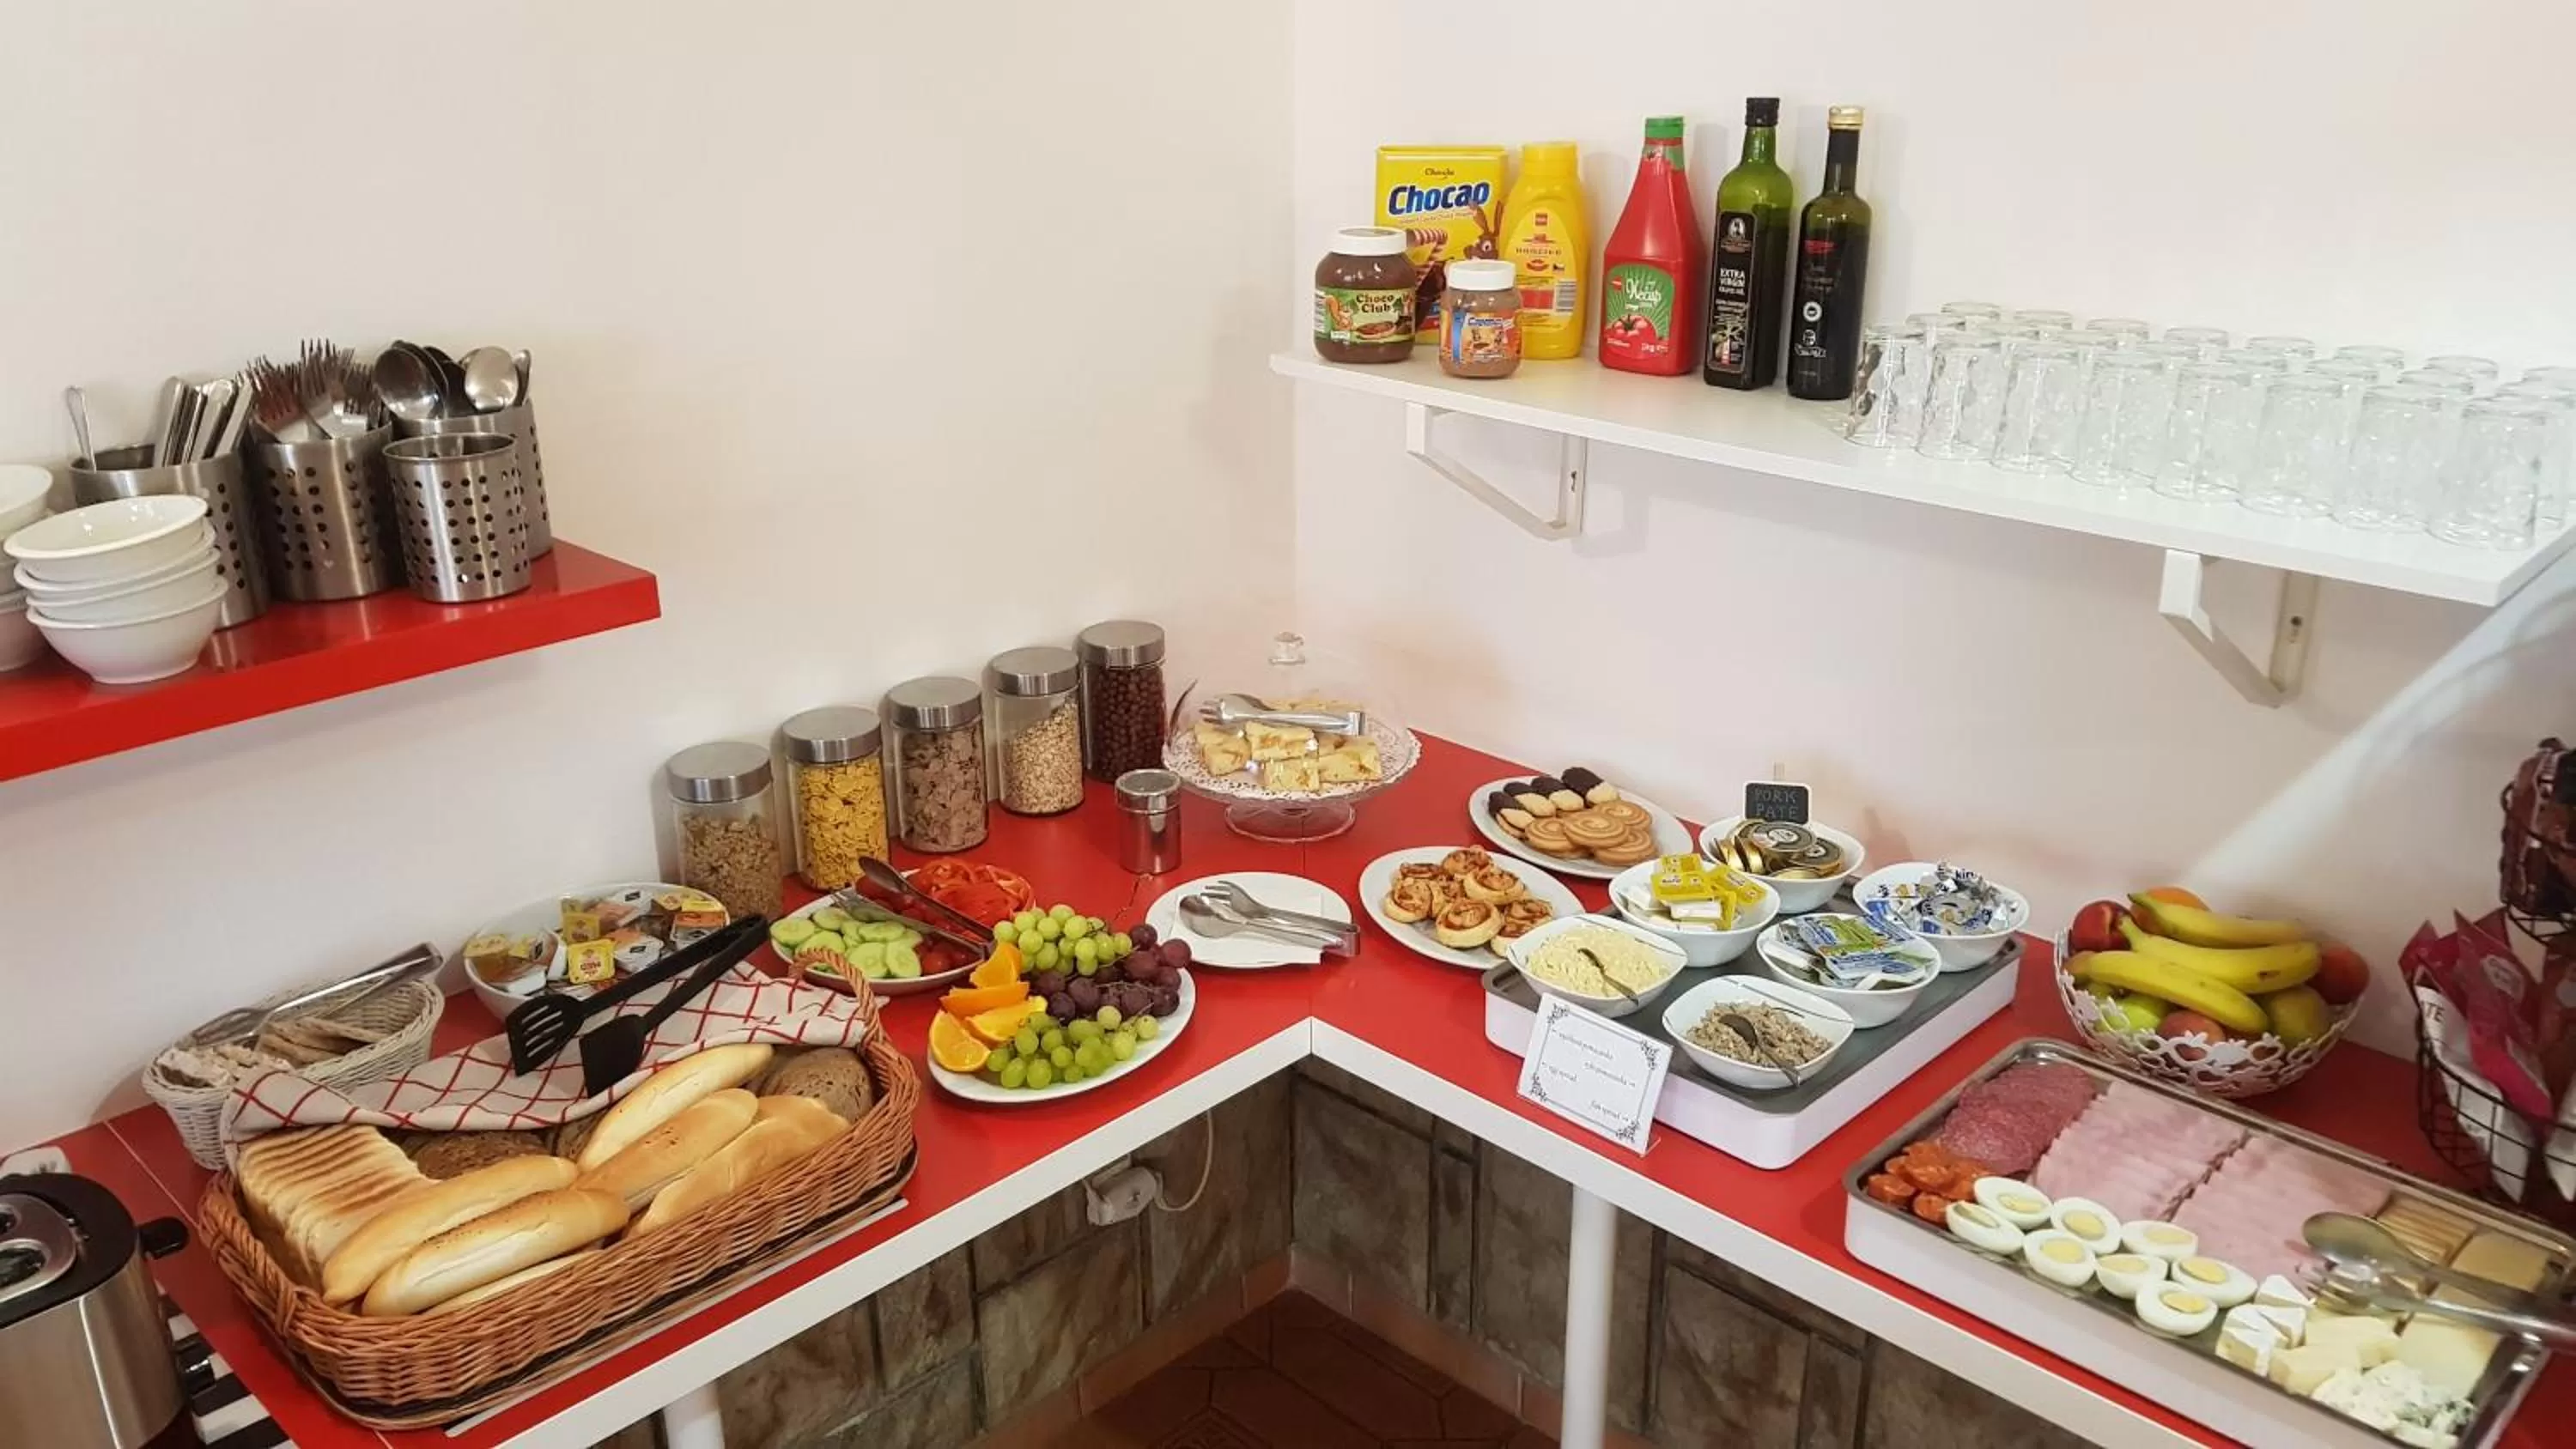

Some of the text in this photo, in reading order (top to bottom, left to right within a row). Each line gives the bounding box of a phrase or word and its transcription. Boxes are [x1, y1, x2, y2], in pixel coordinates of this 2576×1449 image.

[1388, 182, 1490, 215] Chocao
[1356, 293, 1395, 304] Choco
[1361, 303, 1393, 313] Club
[1754, 787, 1799, 804] PORK
[1755, 802, 1799, 821] PATE
